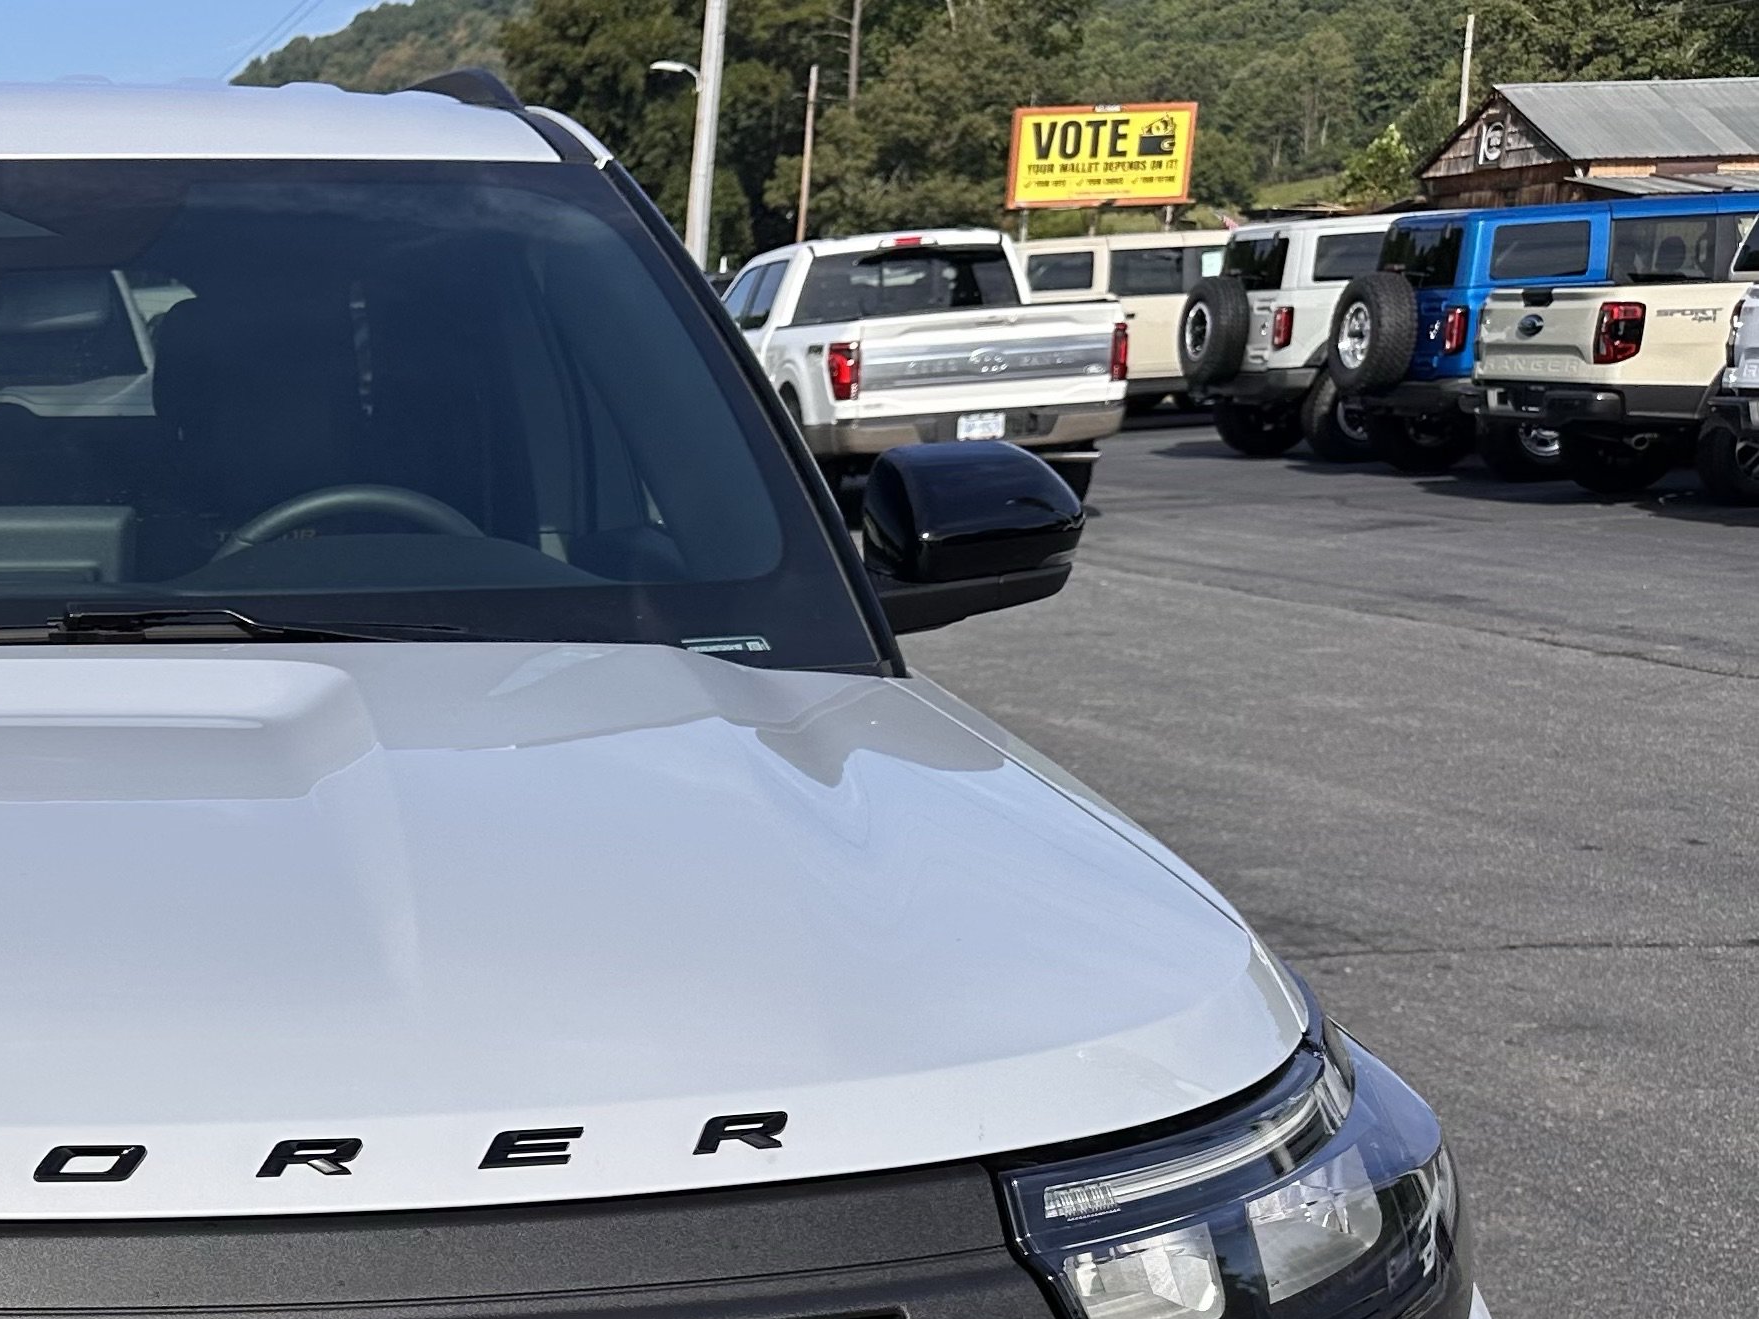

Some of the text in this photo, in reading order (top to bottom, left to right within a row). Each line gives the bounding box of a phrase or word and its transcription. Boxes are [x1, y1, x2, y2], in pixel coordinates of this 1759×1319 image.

[1032, 118, 1130, 160] VOTE
[1027, 163, 1054, 175] YOUR
[1059, 161, 1099, 174] WALLET
[1103, 160, 1147, 173] DEPENDS
[1485, 357, 1580, 373] RANGER
